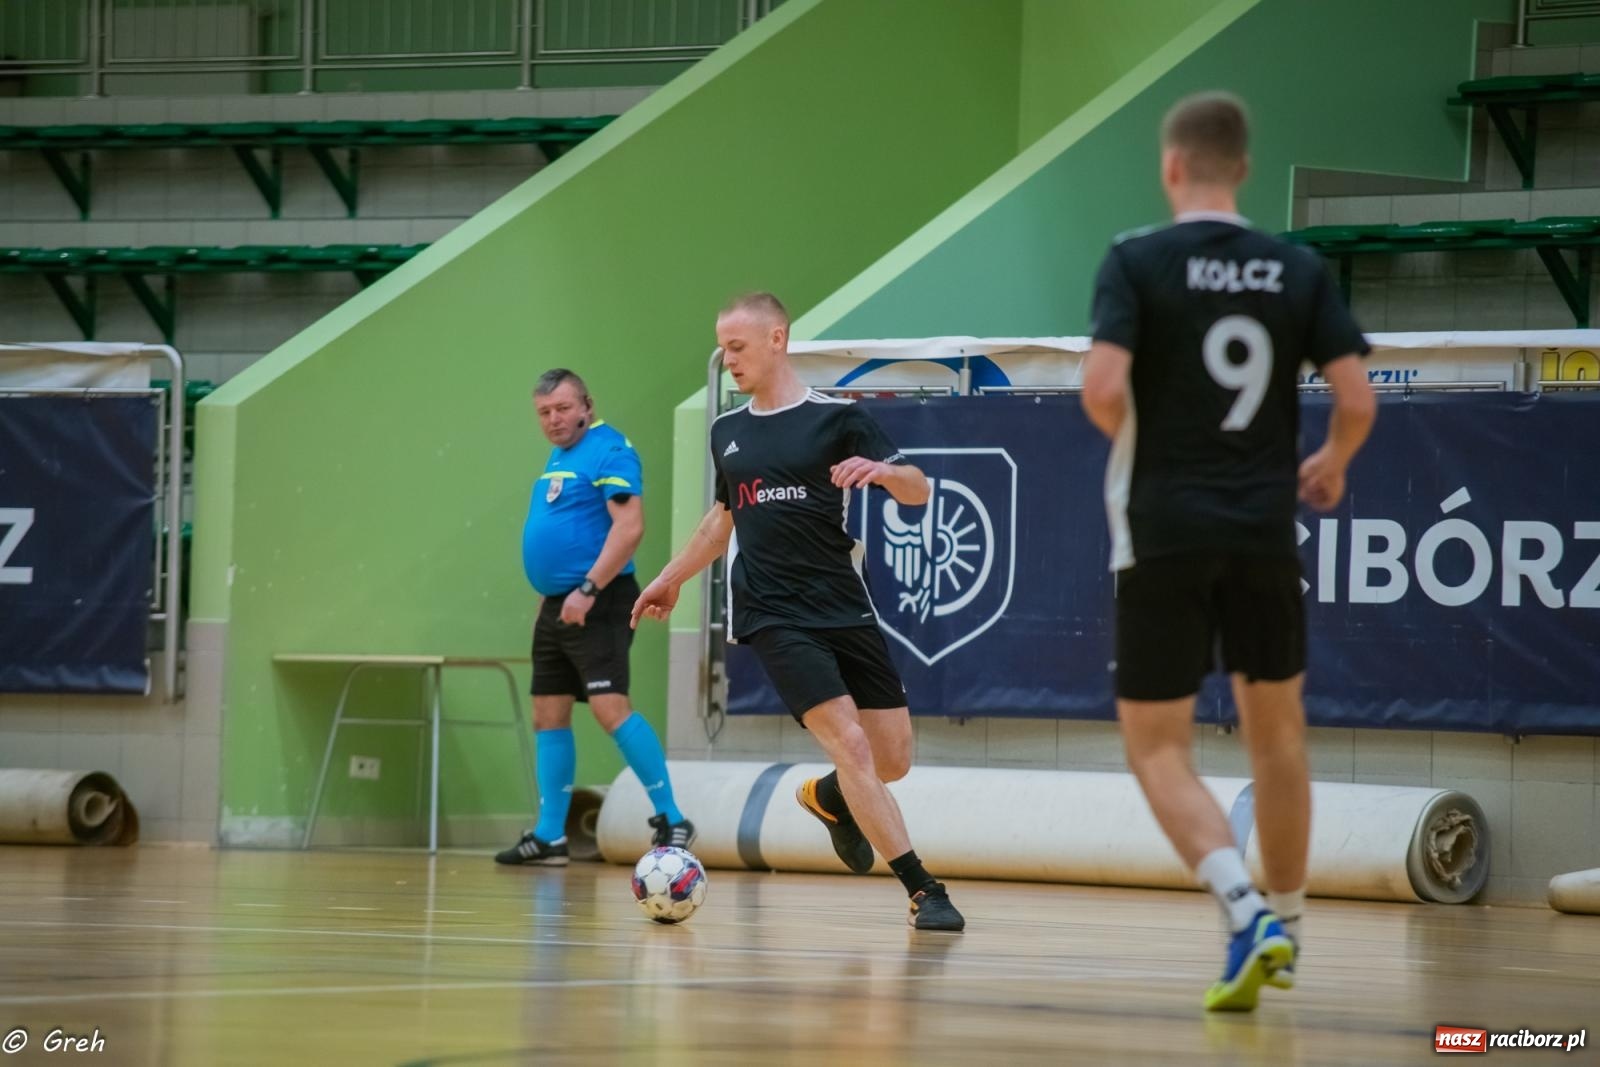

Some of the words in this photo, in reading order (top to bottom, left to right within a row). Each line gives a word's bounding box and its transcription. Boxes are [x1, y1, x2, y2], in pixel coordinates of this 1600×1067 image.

[1186, 256, 1284, 293] KOŁCZ
[1202, 315, 1273, 431] 9
[737, 478, 807, 509] Nexans
[1295, 487, 1600, 609] IBÓRZ
